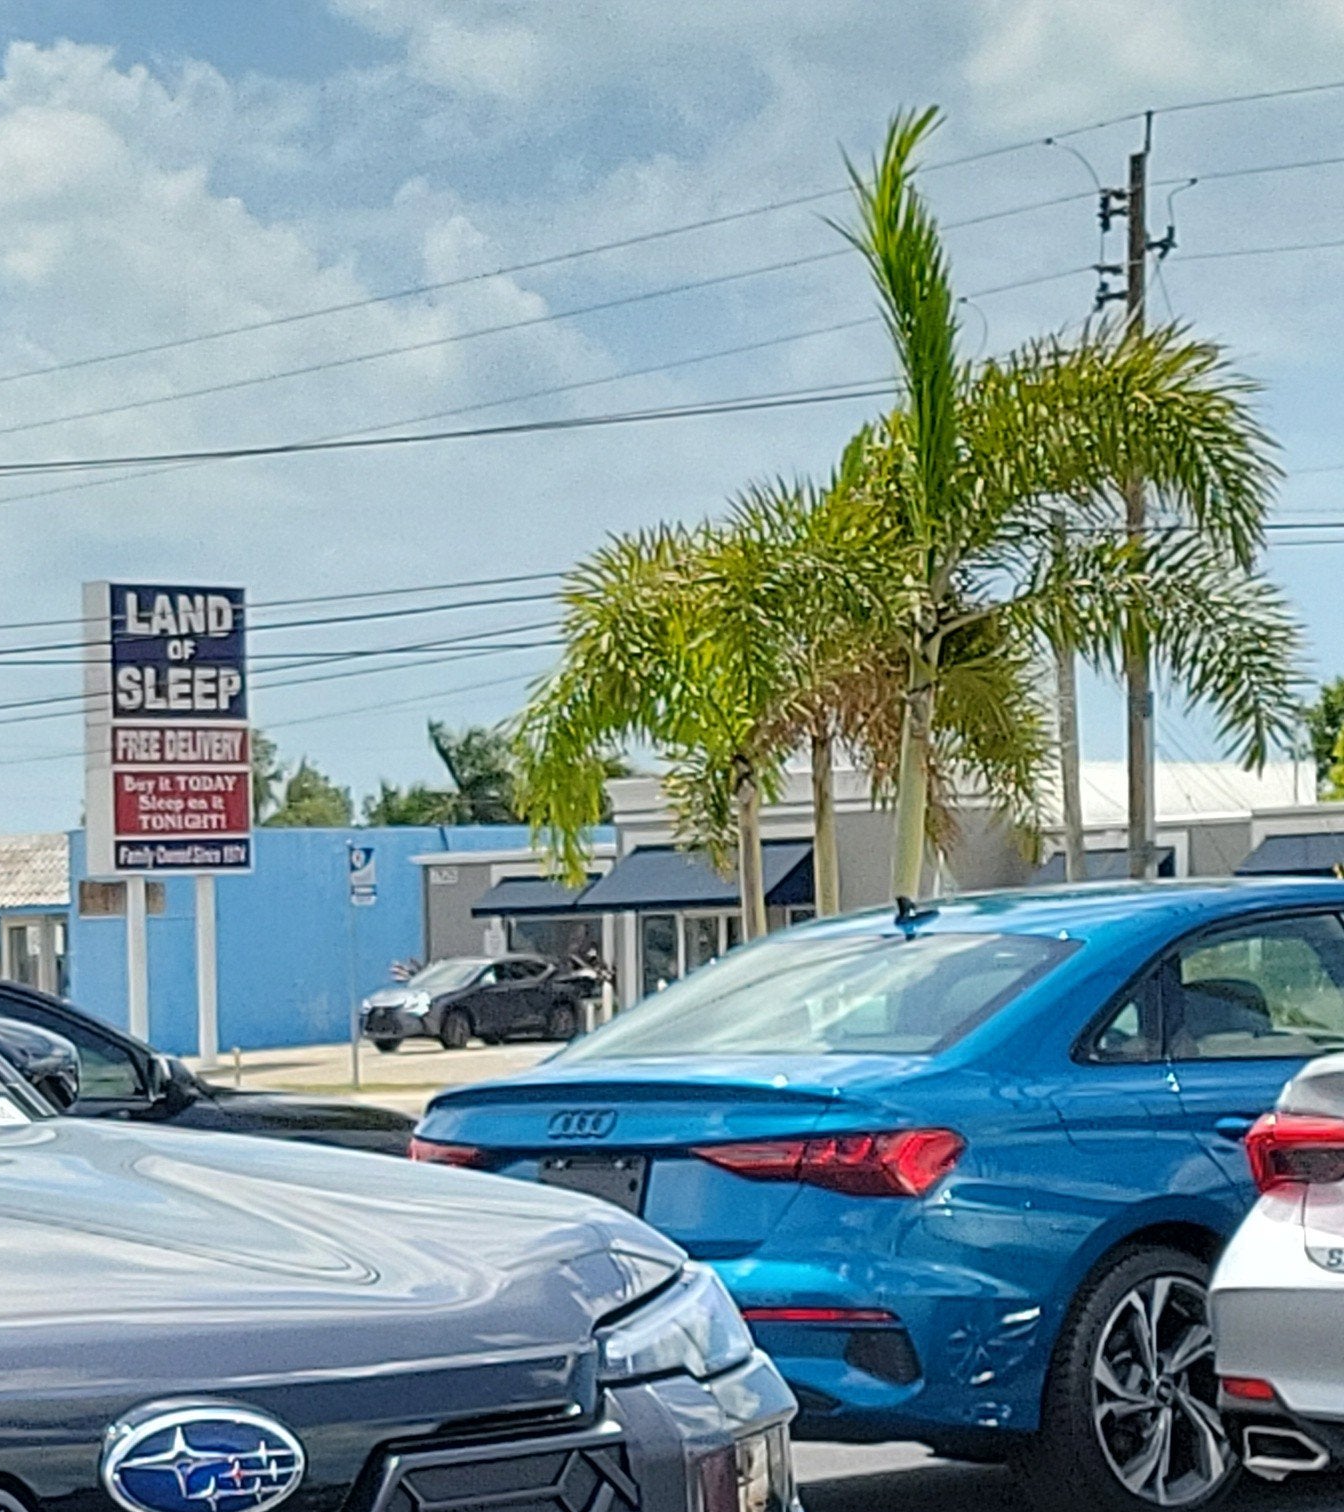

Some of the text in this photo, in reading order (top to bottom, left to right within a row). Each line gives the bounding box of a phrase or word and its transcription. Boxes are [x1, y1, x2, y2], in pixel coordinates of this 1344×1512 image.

[125, 591, 233, 637] LAND
[167, 639, 196, 660] OF
[115, 666, 242, 710] SLEEP
[115, 729, 244, 761] FREE DELIVERY
[123, 775, 155, 794] Buy
[175, 775, 238, 791] TODAY
[138, 795, 185, 812] Sleep
[187, 797, 209, 810] on
[138, 813, 228, 830] TONIGHT!
